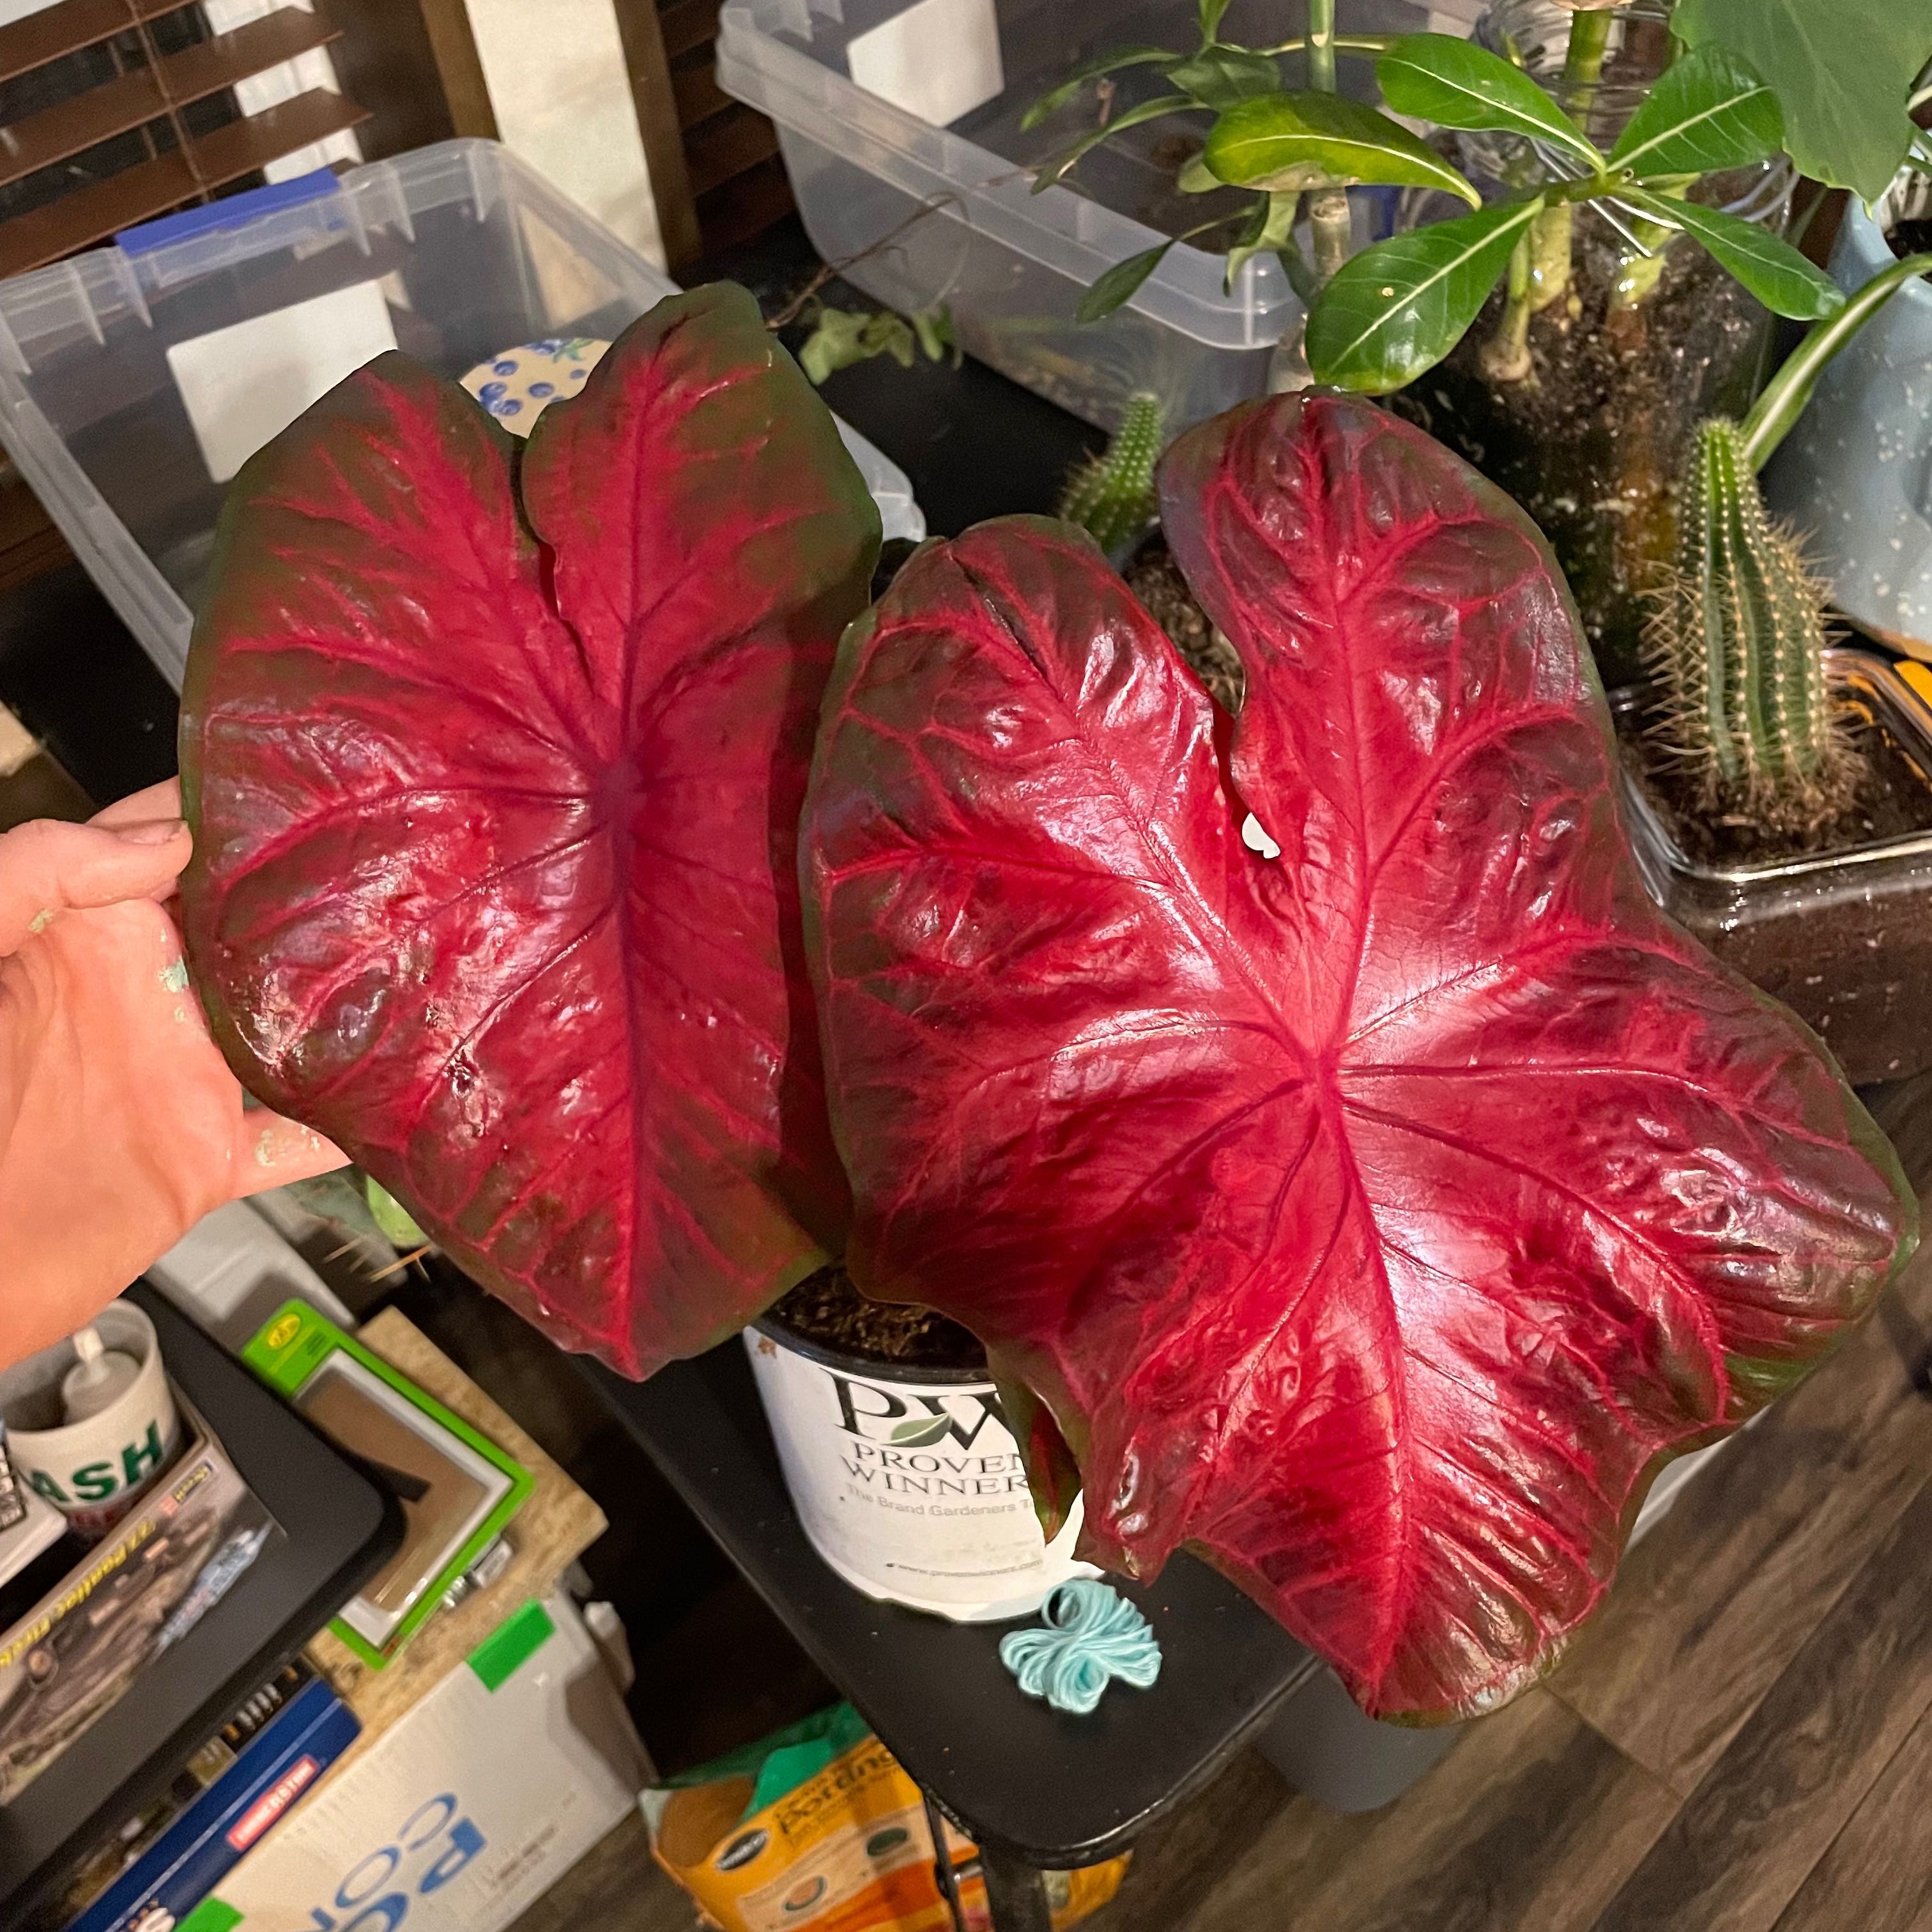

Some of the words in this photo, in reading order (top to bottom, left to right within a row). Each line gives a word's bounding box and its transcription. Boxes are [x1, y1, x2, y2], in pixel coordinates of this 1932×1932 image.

[840, 1455, 1029, 1496] WINNER
[845, 1482, 873, 1503] The
[877, 1495, 925, 1515] Brand
[929, 1503, 1016, 1517] Gardeners
